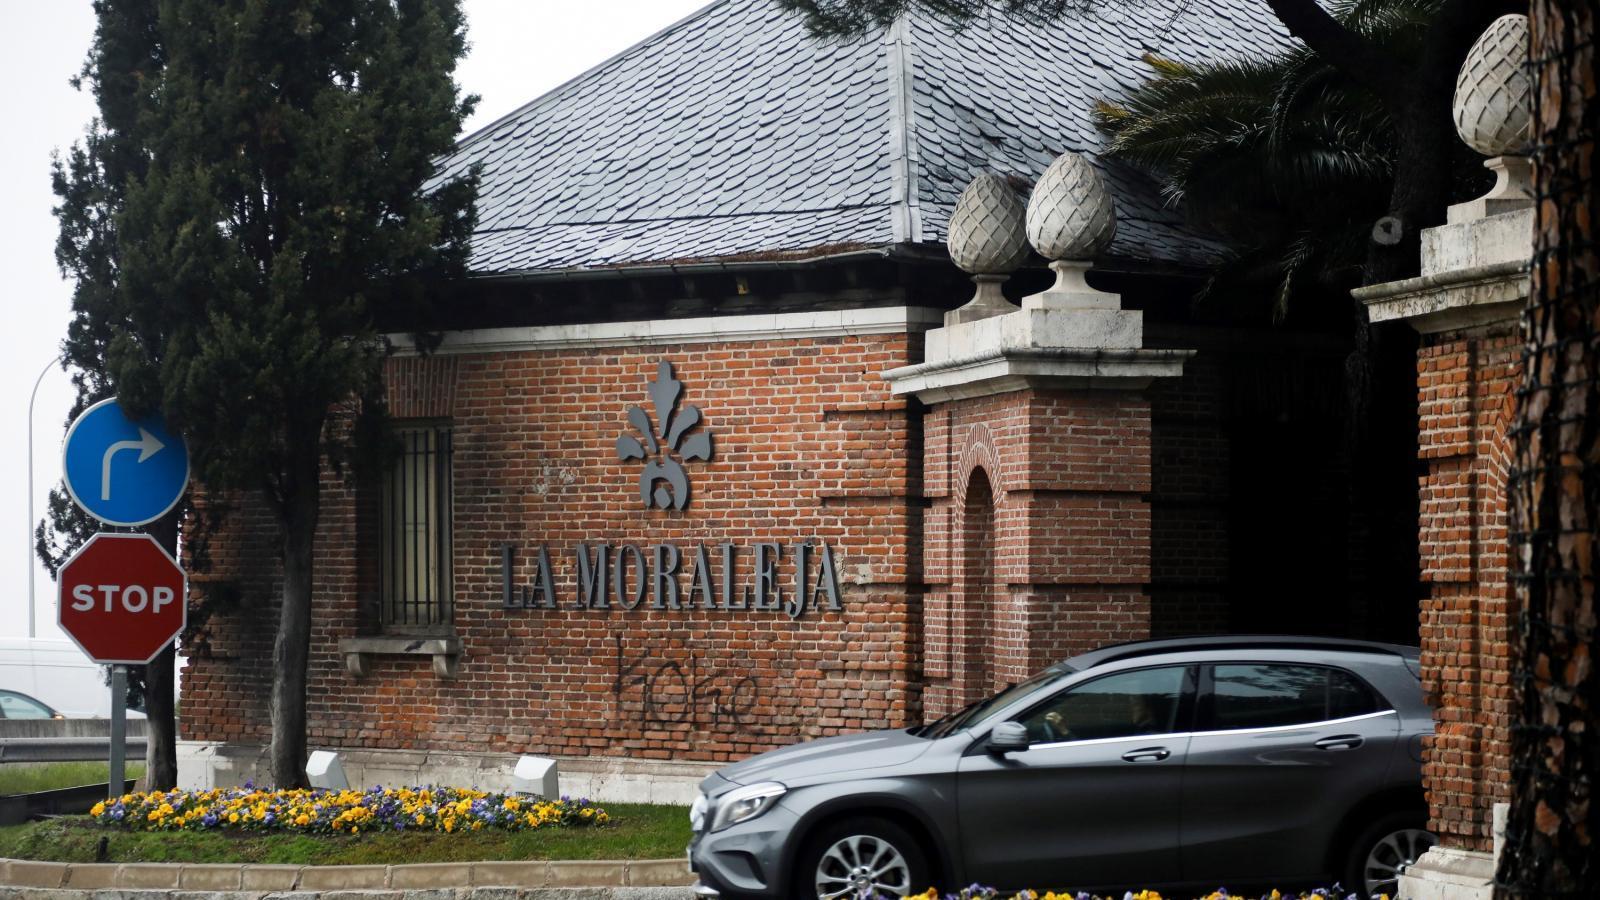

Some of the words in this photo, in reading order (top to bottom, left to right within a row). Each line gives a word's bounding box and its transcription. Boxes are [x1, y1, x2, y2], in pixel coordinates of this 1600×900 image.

[71, 584, 174, 613] STOP
[500, 543, 556, 609] LA
[572, 542, 842, 618] MORALEJA
